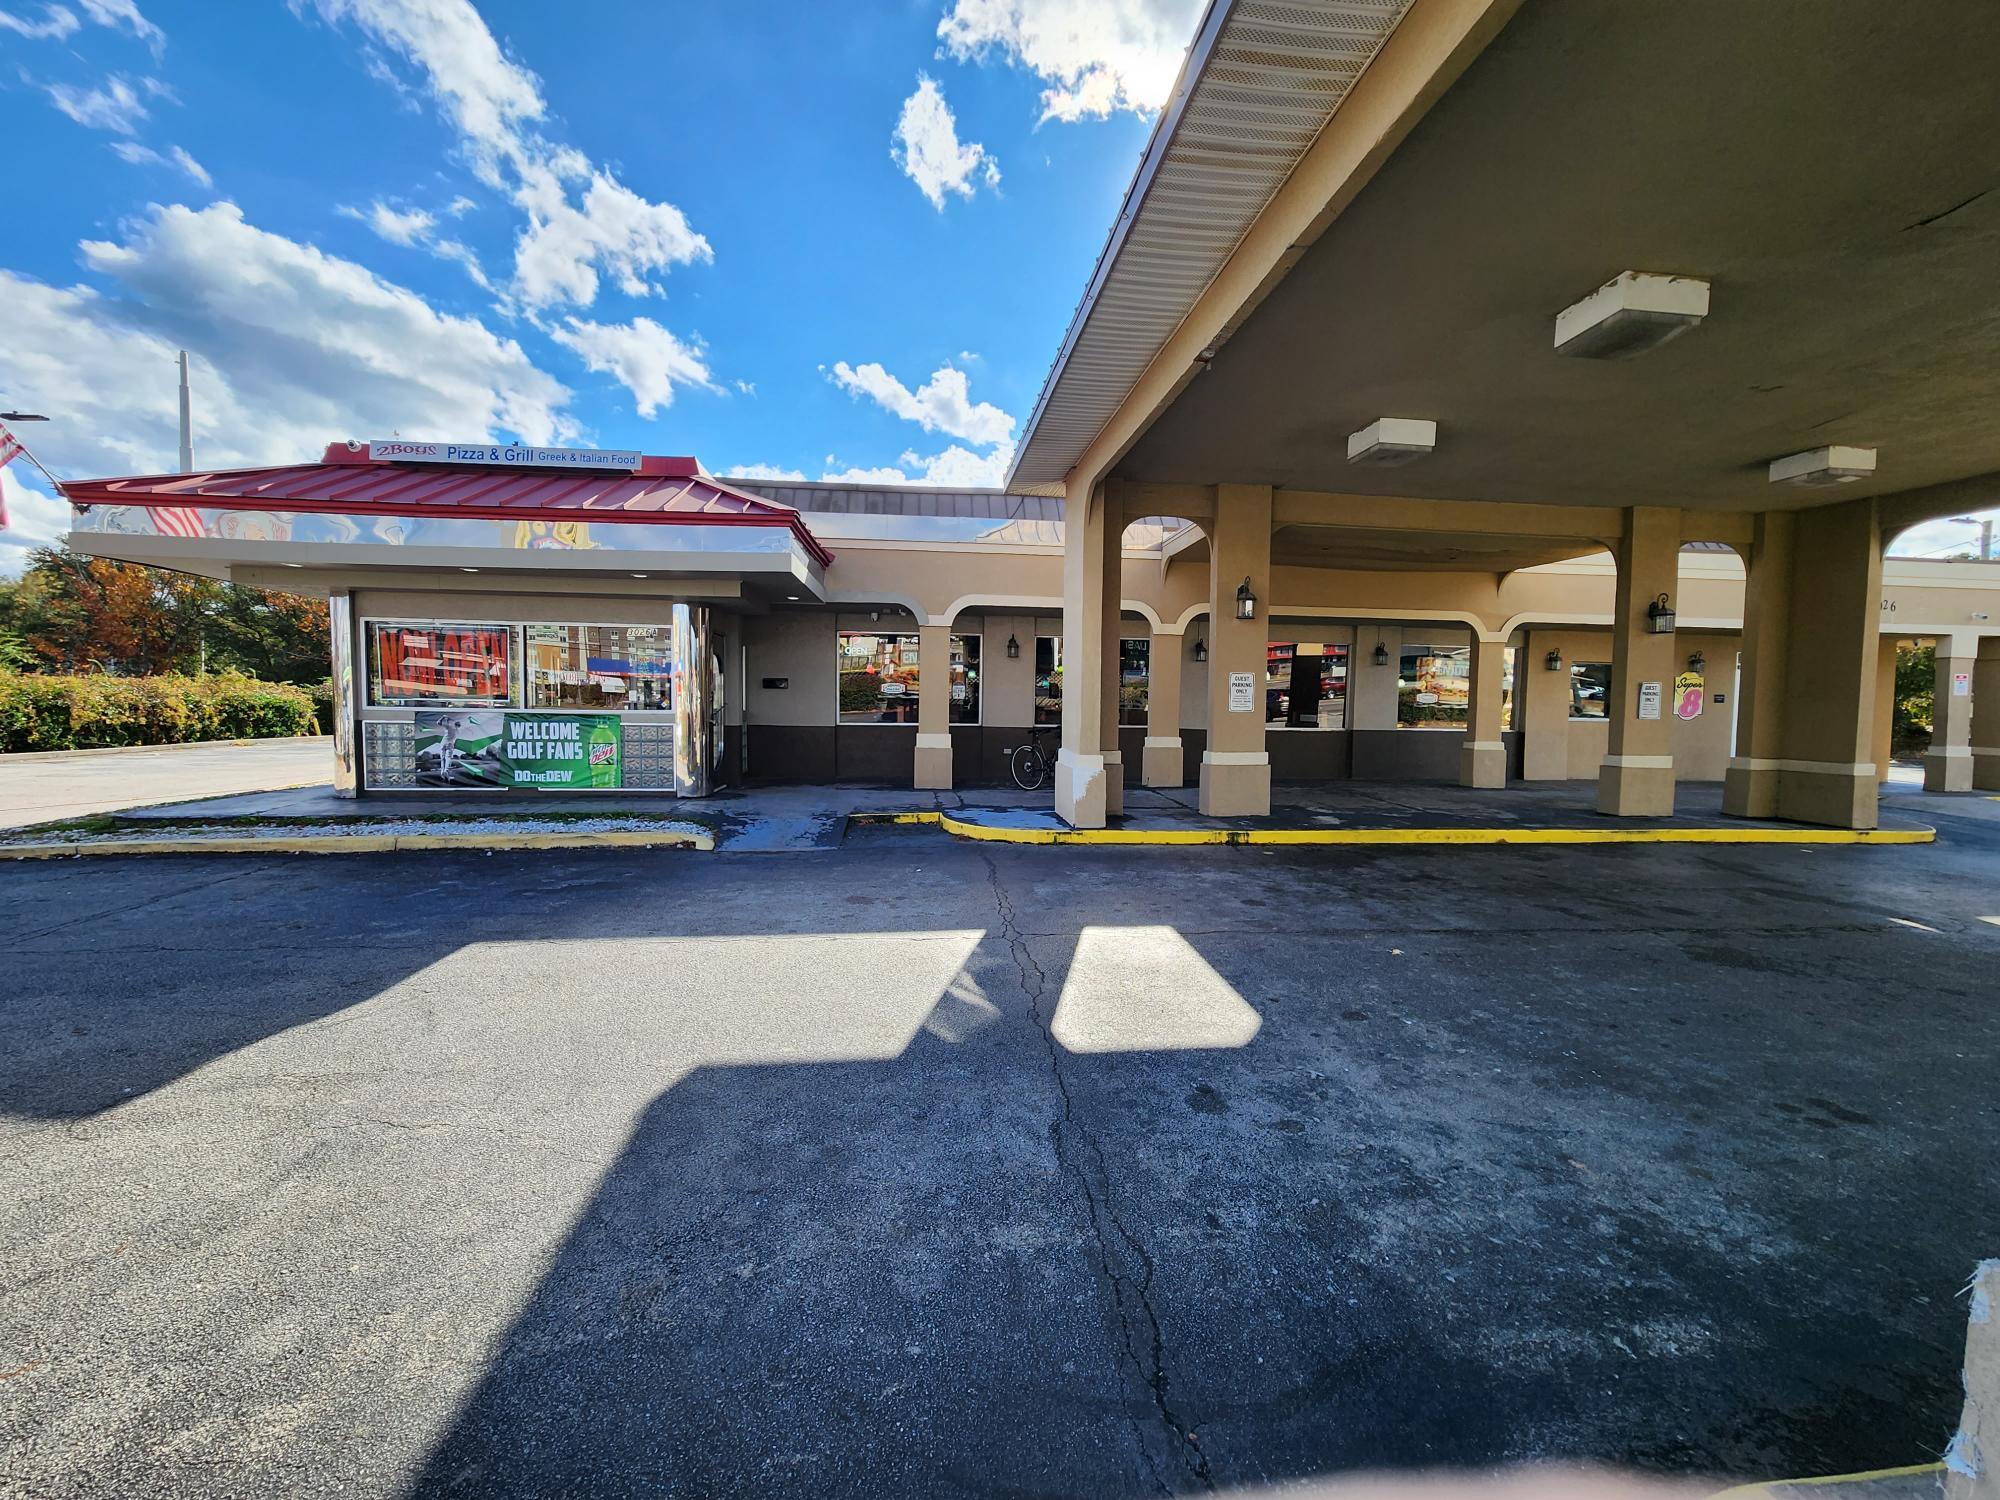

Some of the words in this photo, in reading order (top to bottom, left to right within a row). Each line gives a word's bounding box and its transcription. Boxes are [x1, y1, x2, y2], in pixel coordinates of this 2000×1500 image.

[447, 446, 484, 460] Pizza
[489, 447, 500, 461] &
[504, 448, 534, 462] Grill
[538, 451, 567, 461] Greek
[569, 453, 577, 462] &
[580, 453, 609, 463] Italian
[611, 454, 636, 464] Food
[1880, 599, 1896, 612] 26
[844, 646, 868, 655] OPEN
[1676, 677, 1703, 694] Super
[1678, 688, 1702, 718] 8
[510, 721, 580, 740] WELCOME
[507, 741, 543, 759] GOLF
[546, 741, 583, 759] FANS
